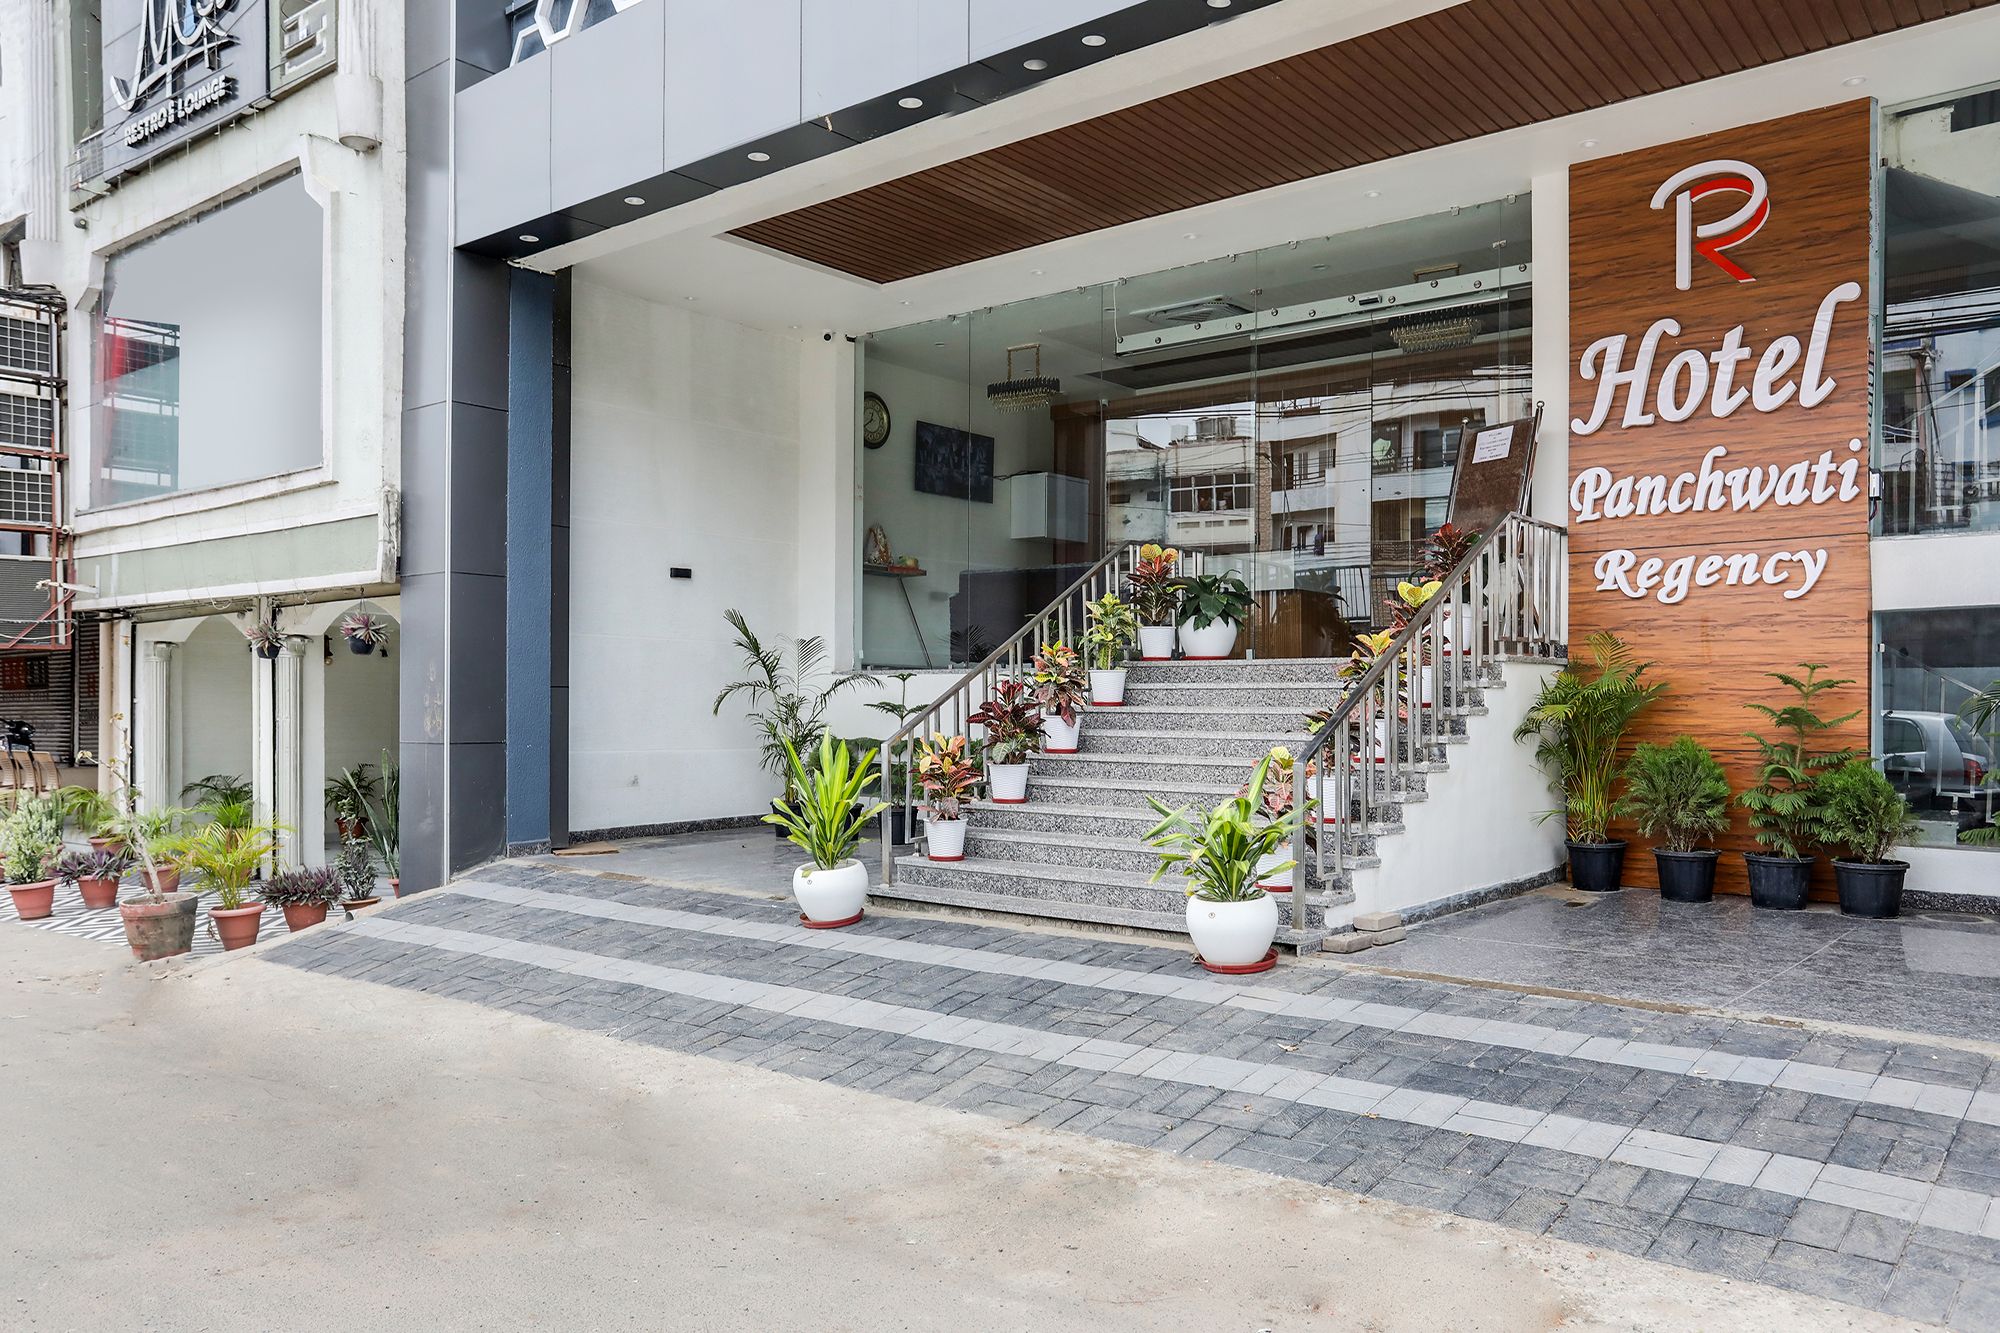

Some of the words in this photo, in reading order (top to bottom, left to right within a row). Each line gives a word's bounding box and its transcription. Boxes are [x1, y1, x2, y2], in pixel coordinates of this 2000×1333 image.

[124, 107, 168, 146] RESTRO
[177, 74, 226, 119] LOUNGE
[1570, 281, 1862, 436] Hotel
[1570, 438, 1863, 524] Panchwati
[1594, 548, 1829, 605] Regency
